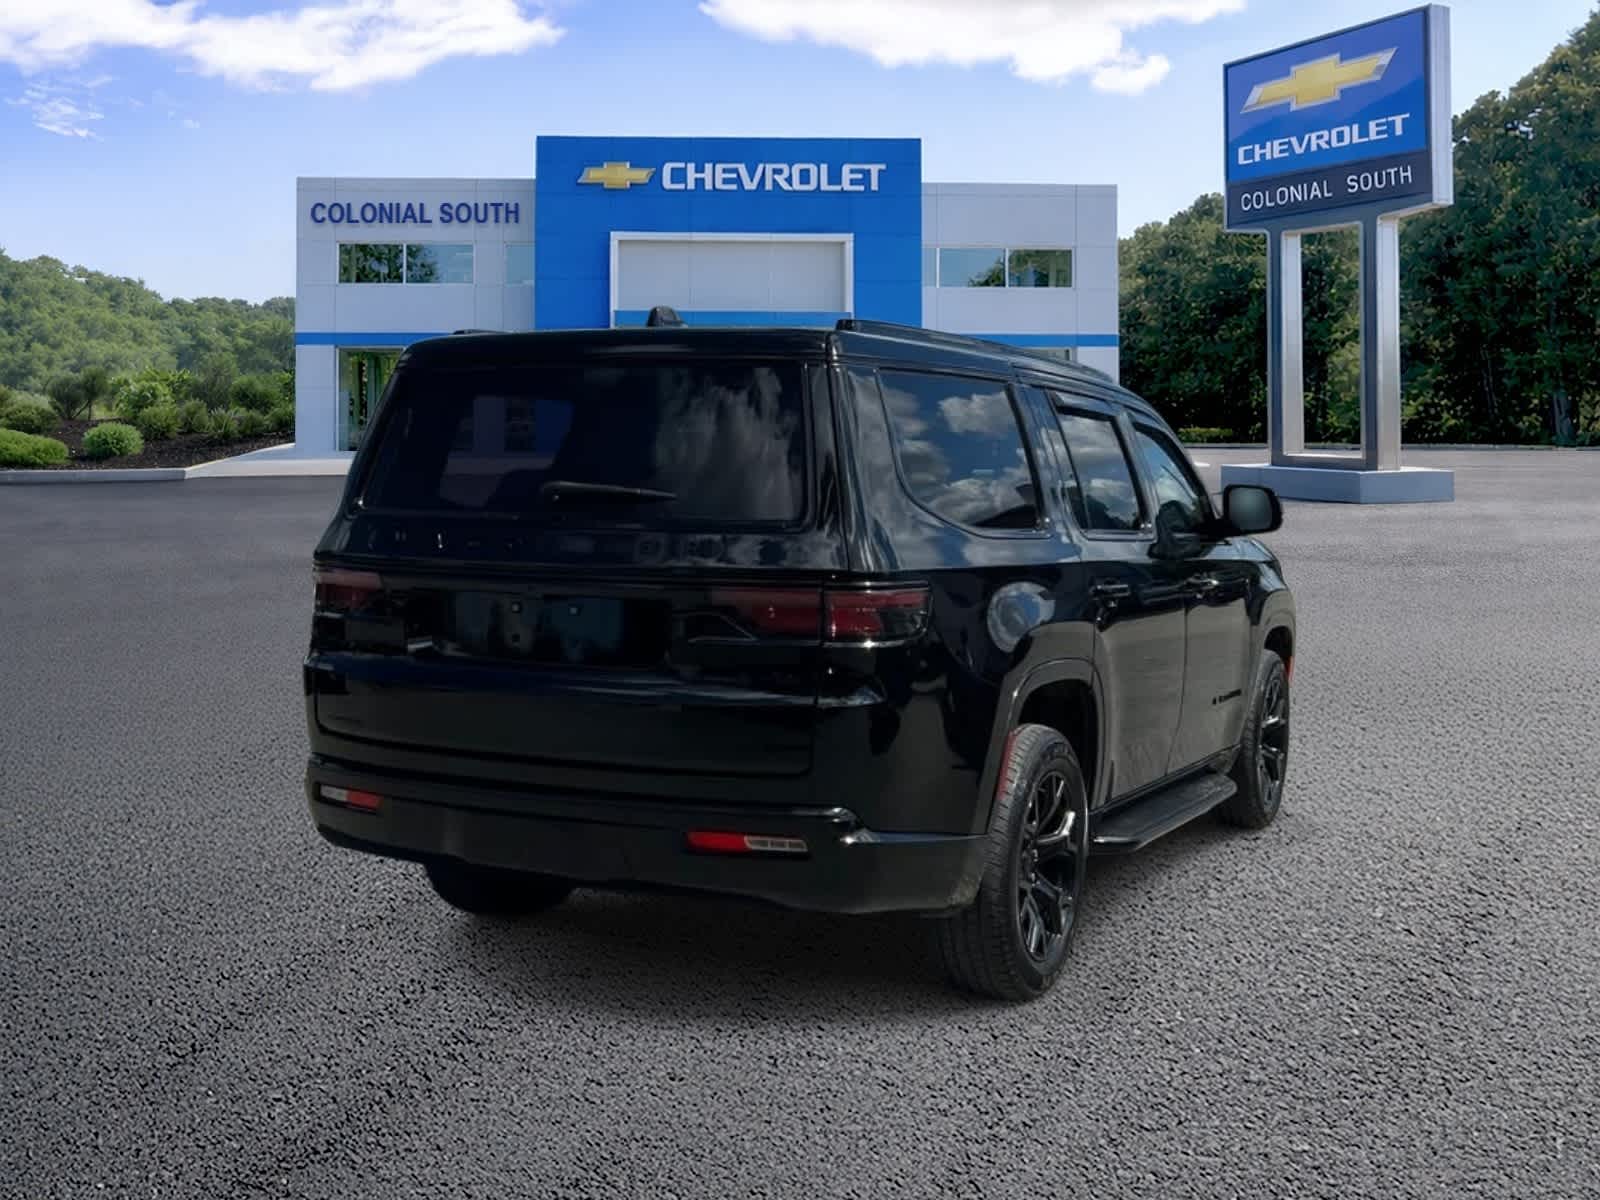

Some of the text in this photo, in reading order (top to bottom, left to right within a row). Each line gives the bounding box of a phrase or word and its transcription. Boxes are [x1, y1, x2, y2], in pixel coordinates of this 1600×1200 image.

[1238, 113, 1410, 165] CHEVROLET
[662, 162, 887, 192] CHEVROLET
[1240, 166, 1412, 211] COLONIAL SOUTH
[310, 202, 520, 225] COLONIAL SOUTH
